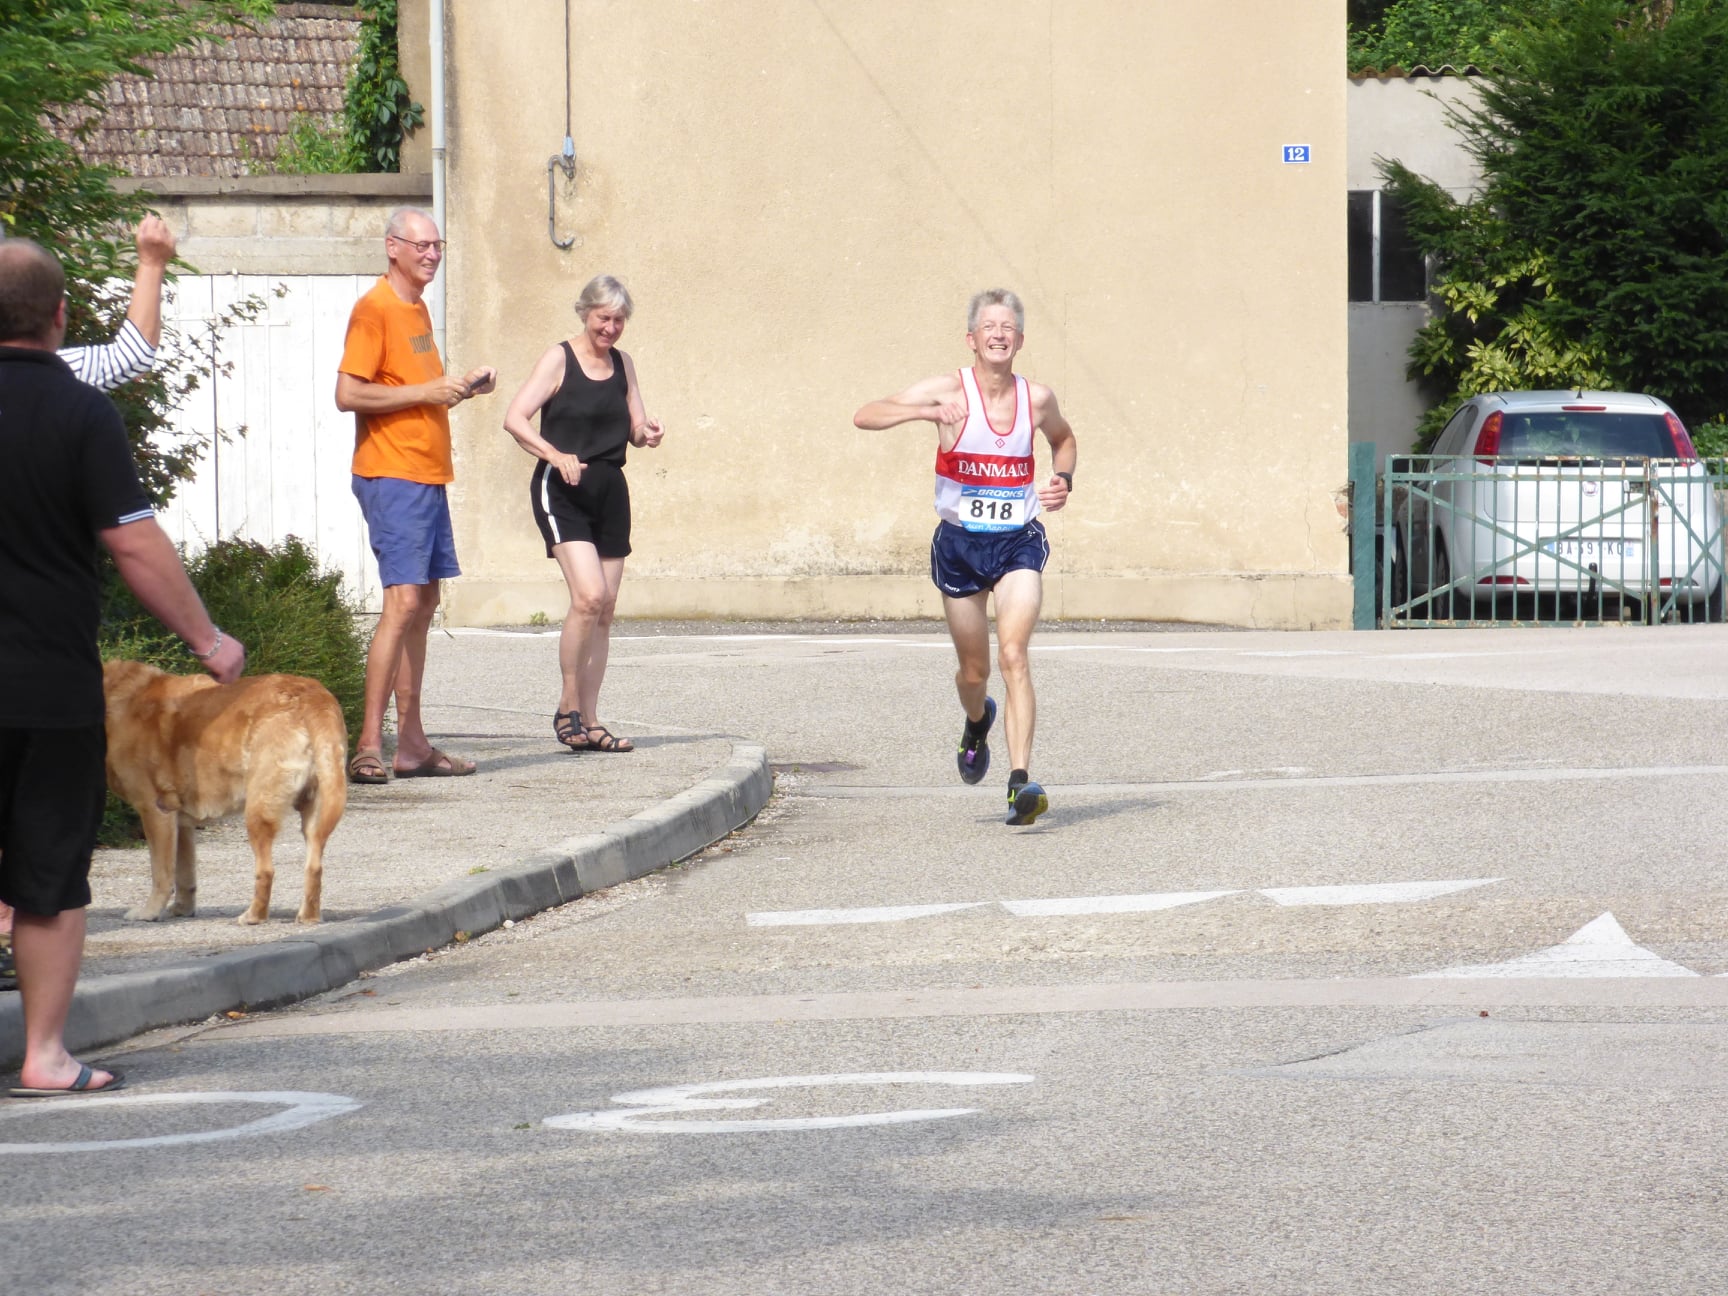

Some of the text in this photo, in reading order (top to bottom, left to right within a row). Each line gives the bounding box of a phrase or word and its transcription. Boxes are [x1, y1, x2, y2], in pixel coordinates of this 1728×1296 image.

[1287, 147, 1305, 161] 12
[977, 489, 1023, 498] BROOKS
[970, 499, 1013, 520] 818
